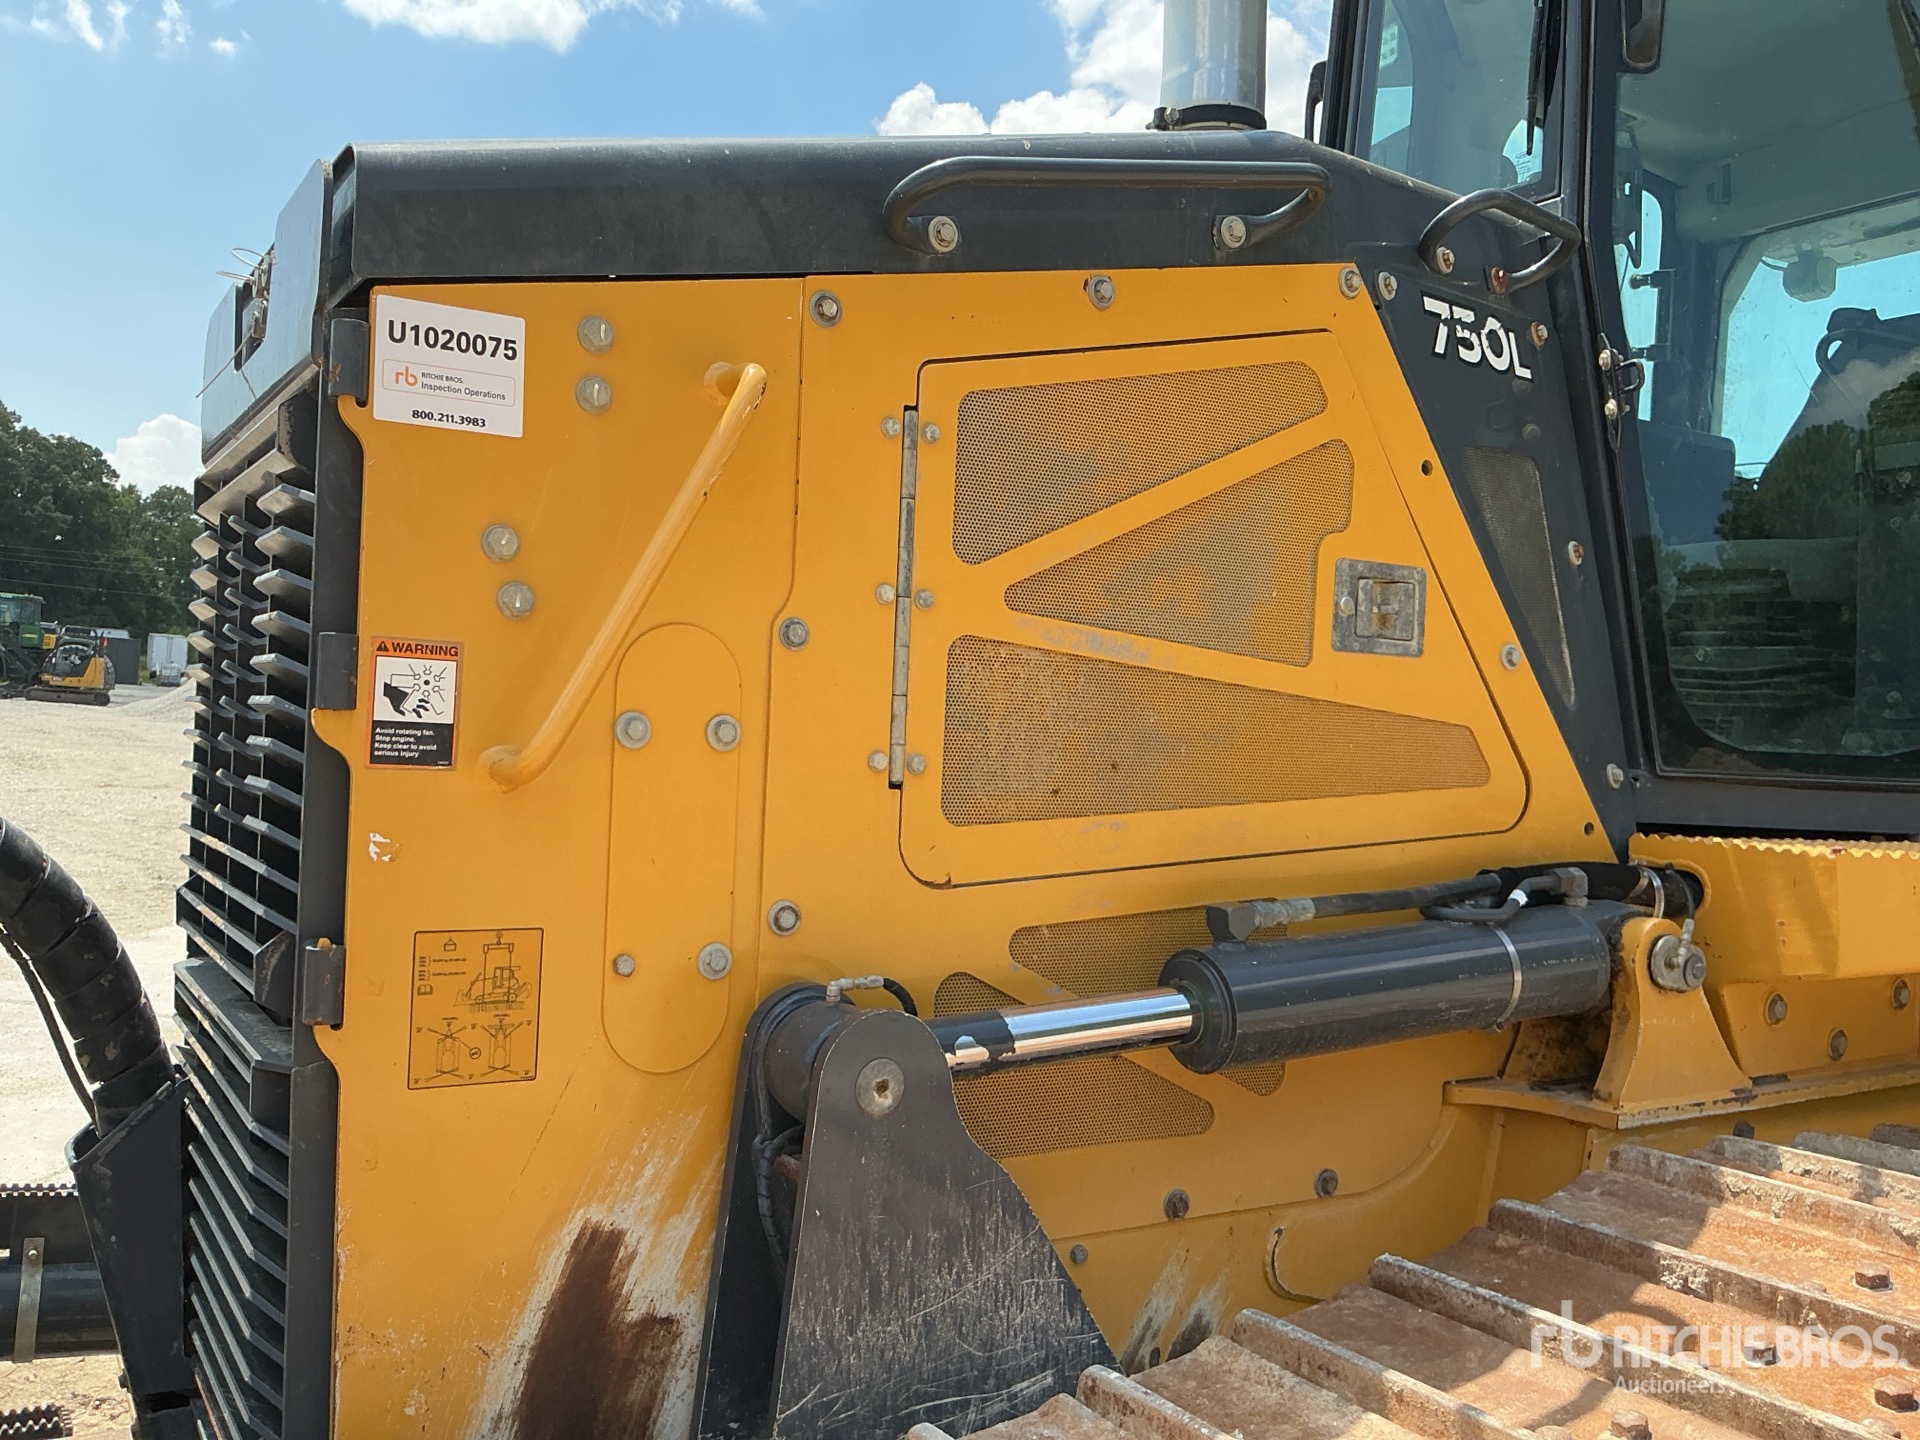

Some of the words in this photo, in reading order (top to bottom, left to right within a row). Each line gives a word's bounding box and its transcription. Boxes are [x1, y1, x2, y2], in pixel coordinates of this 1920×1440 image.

[388, 320, 517, 360] U1020075
[1423, 296, 1532, 379] 750L
[395, 366, 418, 387] rb
[421, 372, 444, 381] RITCHIE
[445, 374, 464, 384] BROS.
[421, 382, 462, 394] Inspection
[464, 387, 506, 401] Operations
[412, 410, 486, 427] 800.211.3983
[392, 642, 459, 657] WARNING
[396, 728, 421, 736] rotating
